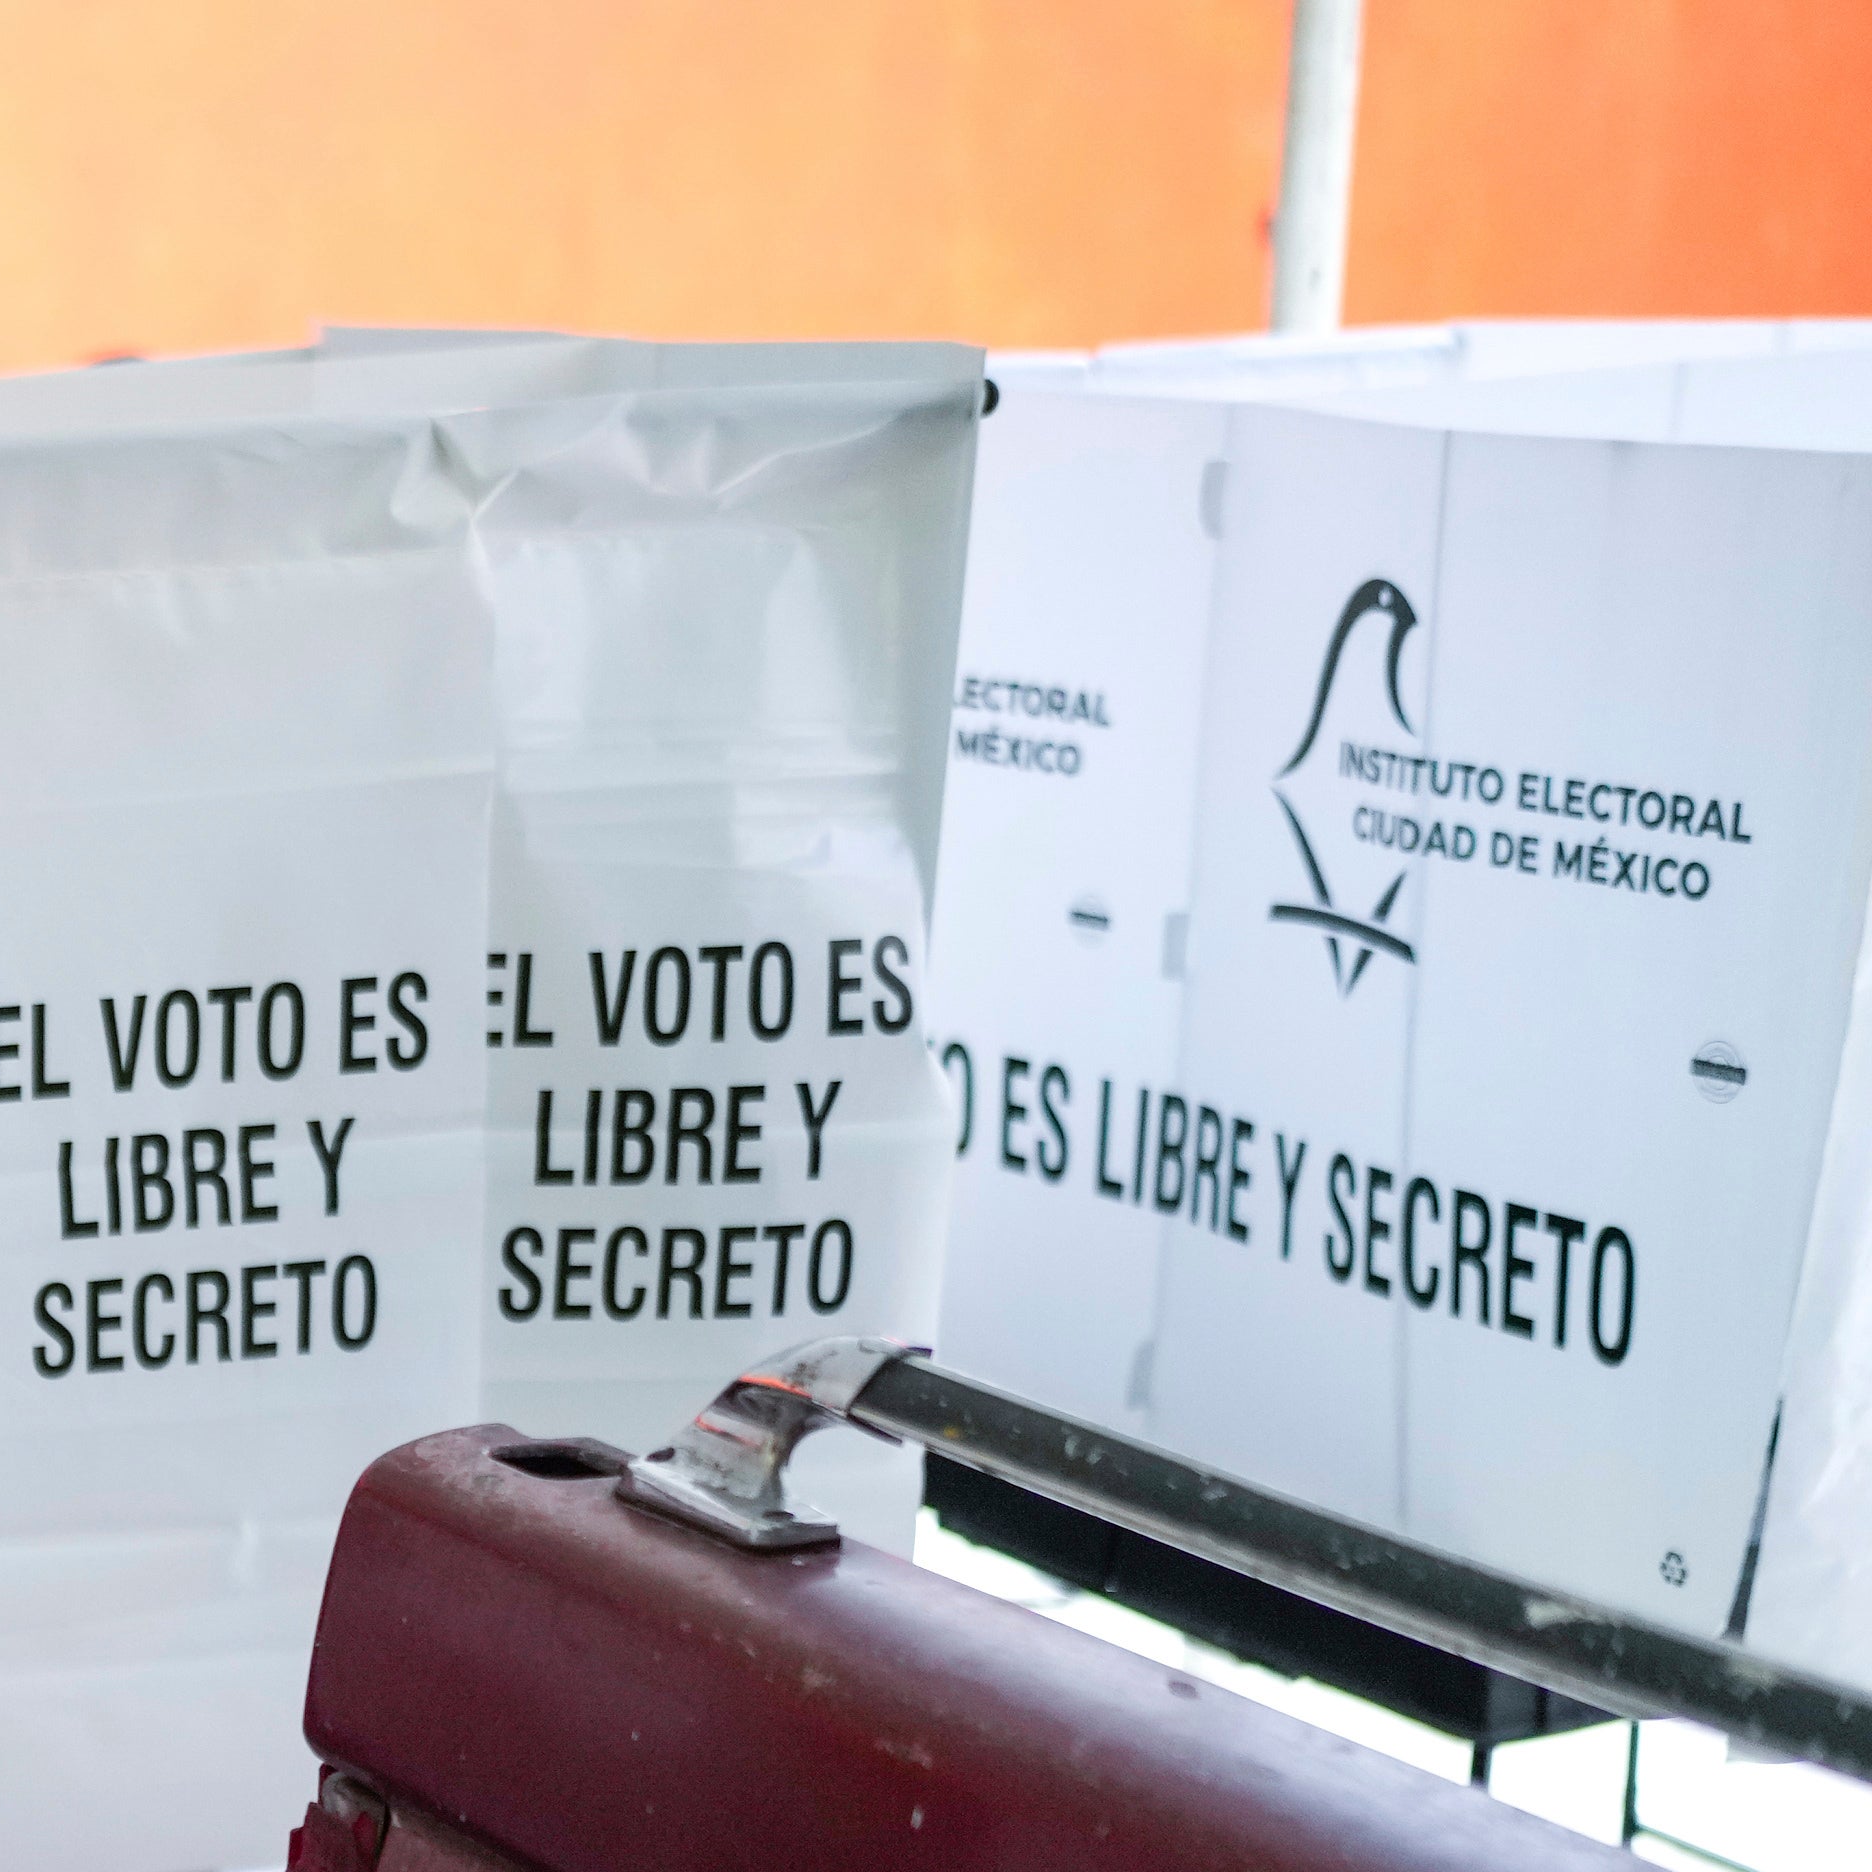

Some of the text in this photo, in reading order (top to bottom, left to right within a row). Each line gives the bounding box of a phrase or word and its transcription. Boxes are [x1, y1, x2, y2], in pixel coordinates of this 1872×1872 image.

[1338, 740, 1753, 845] INSTITUTO ELECTORAL
[1353, 805, 1710, 900] CIUDAD DE MÉXICO
[99, 981, 306, 1096] VOTO
[337, 970, 431, 1077] ES
[587, 940, 795, 1048] VOTO
[825, 933, 915, 1038] ES
[57, 1116, 356, 1242] LIBRE Y
[532, 1079, 843, 1188] LIBRE Y
[1000, 1055, 1070, 1186] ES
[1095, 1076, 1254, 1246] LIBRE
[1275, 1130, 1307, 1262] Y
[1323, 1152, 1637, 1370] SECRETO
[31, 1254, 378, 1382] SECRETO
[497, 1218, 853, 1323] SECRETO
